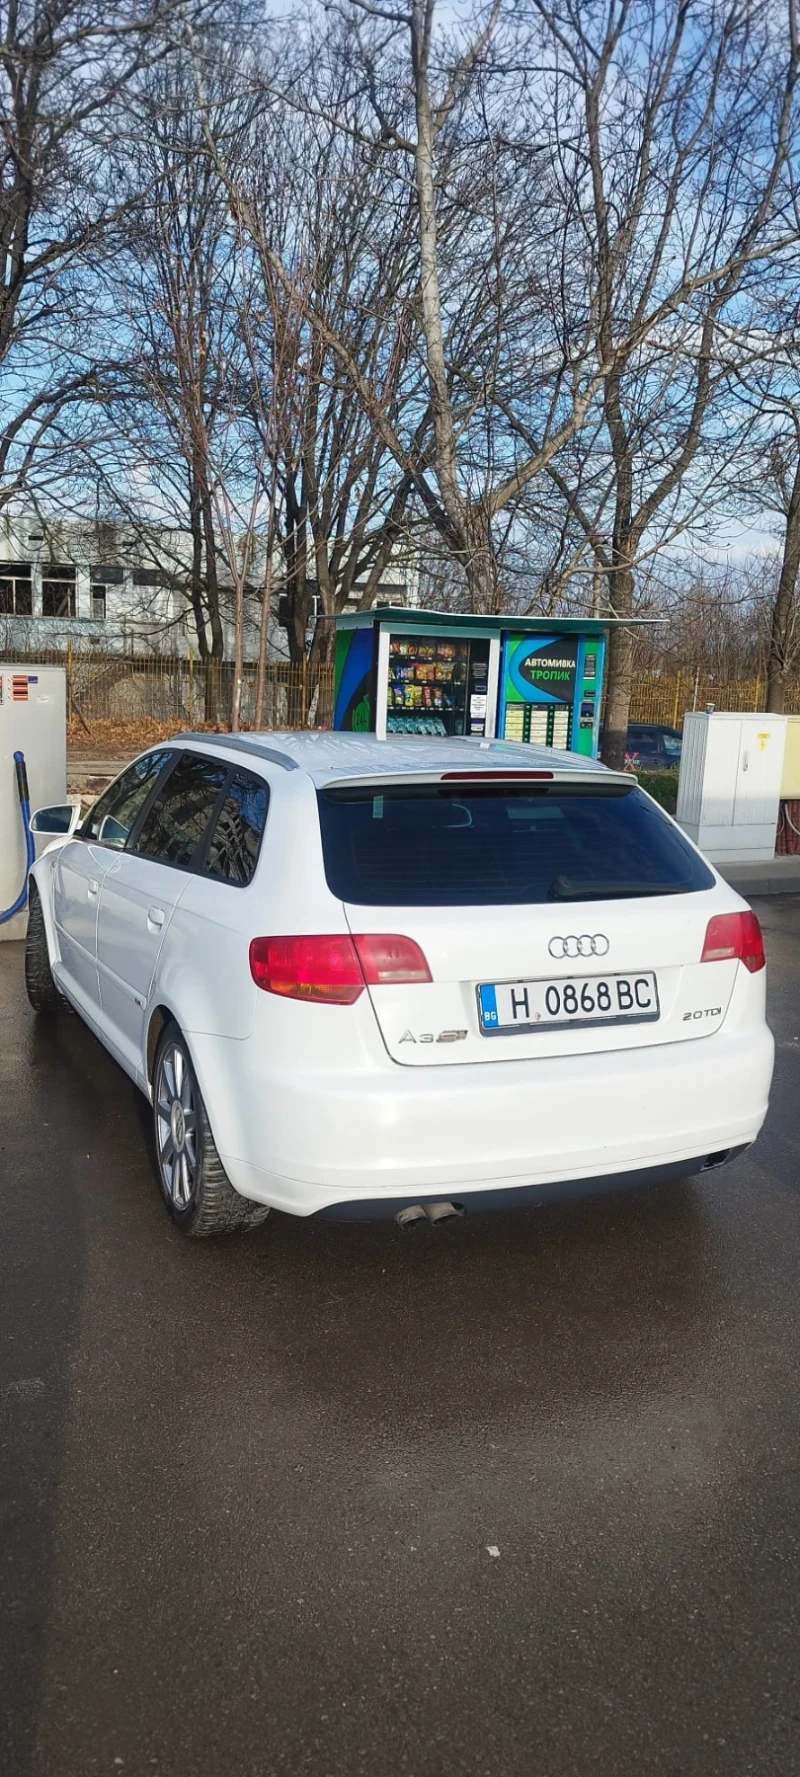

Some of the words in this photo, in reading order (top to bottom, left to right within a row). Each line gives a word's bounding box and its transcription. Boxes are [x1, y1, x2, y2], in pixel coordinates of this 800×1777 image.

[524, 658, 576, 668] АВТОМИВКА
[530, 669, 570, 681] ТРОПИК
[510, 987, 530, 1019] H
[545, 981, 611, 1016] 0868
[616, 978, 651, 1010] BC
[484, 1010, 497, 1021] BG
[398, 1029, 434, 1044] A3
